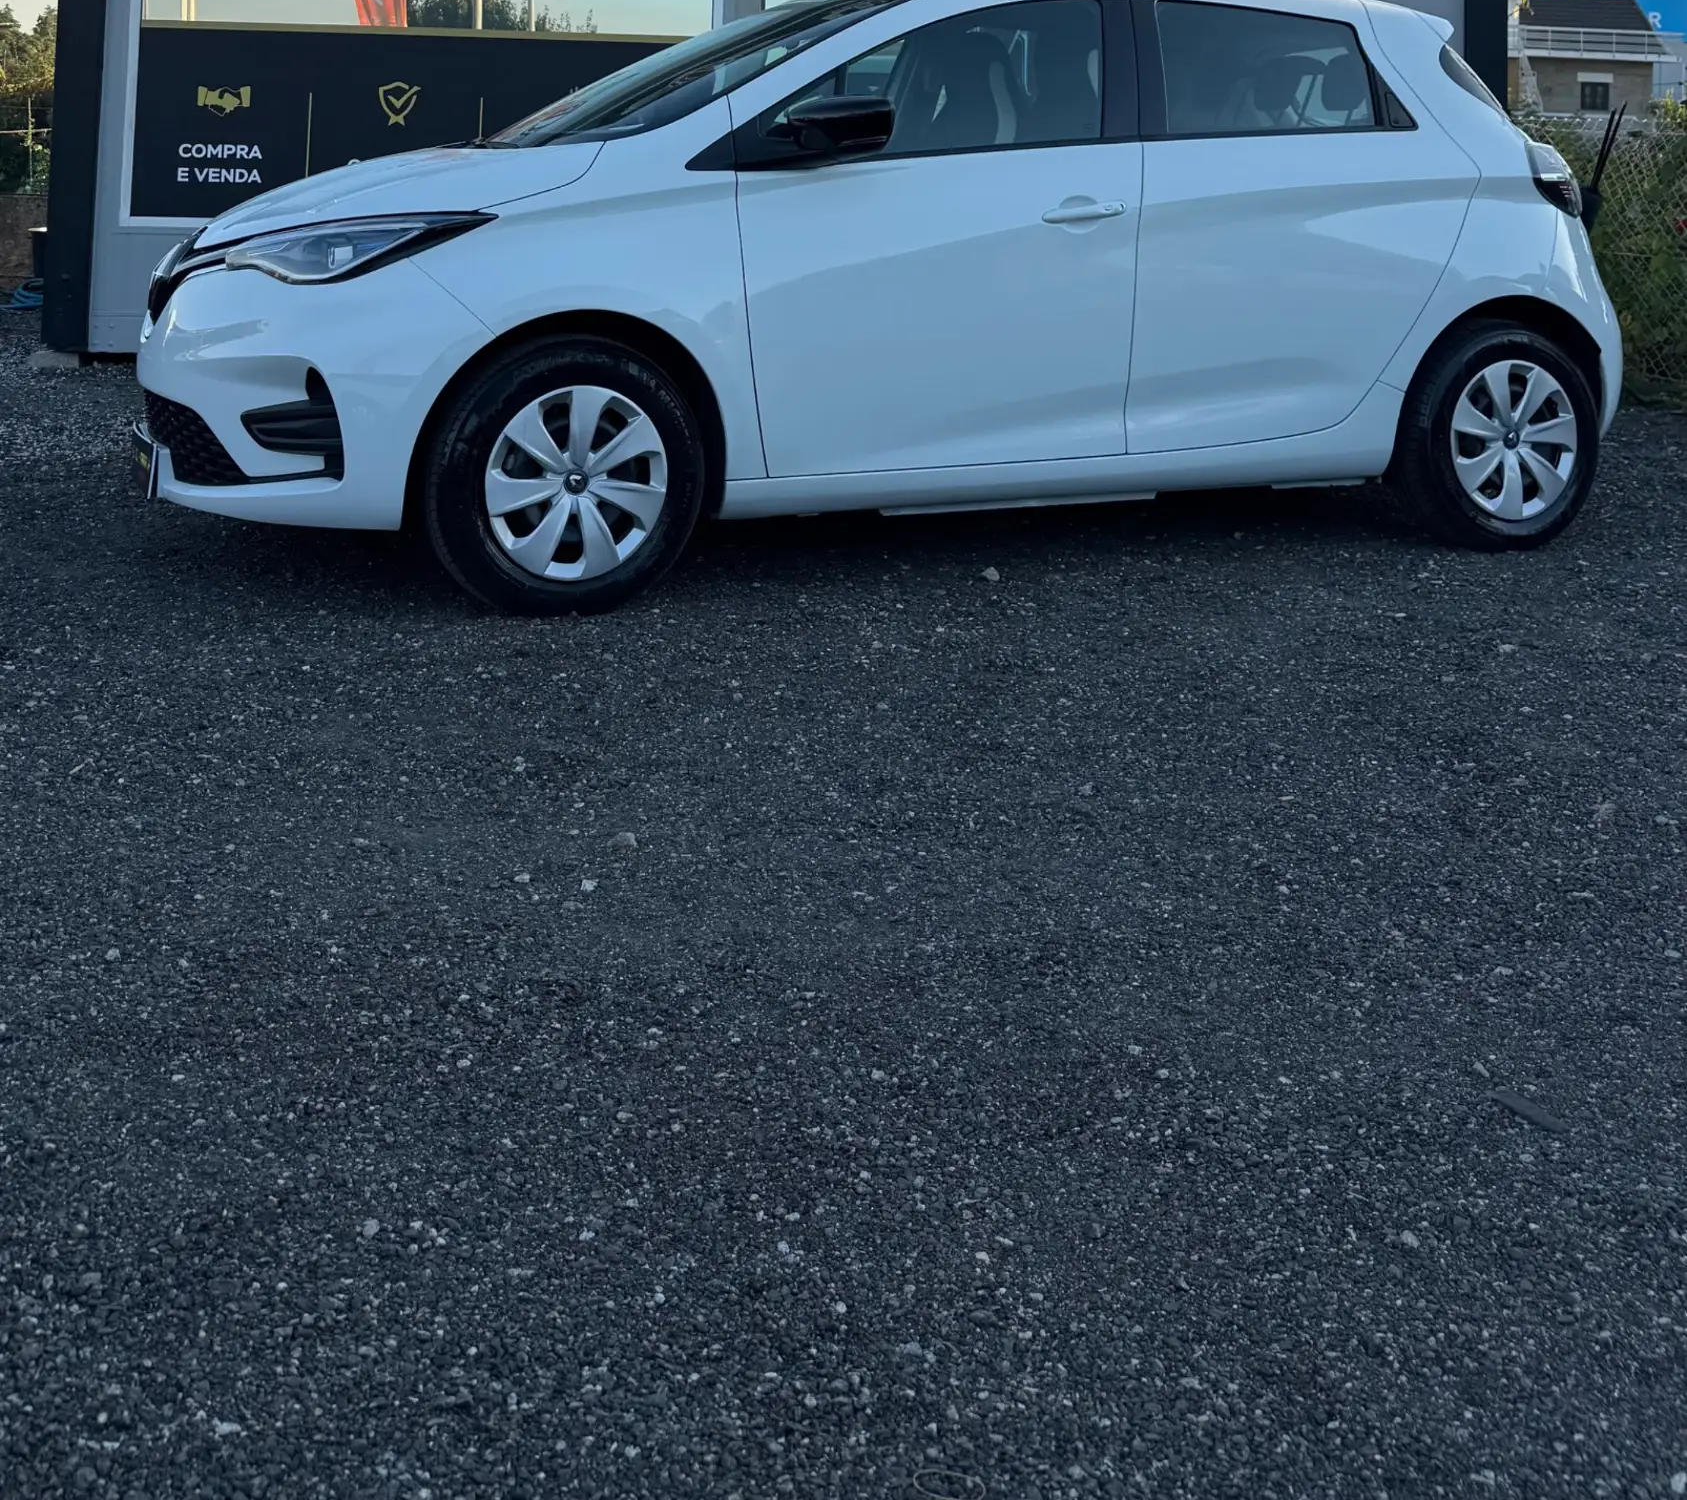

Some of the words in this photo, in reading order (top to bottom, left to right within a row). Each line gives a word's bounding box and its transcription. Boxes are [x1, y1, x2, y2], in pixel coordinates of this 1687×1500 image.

[178, 143, 263, 160] COMPRA
[176, 167, 189, 182] E
[194, 167, 262, 184] VENDA
